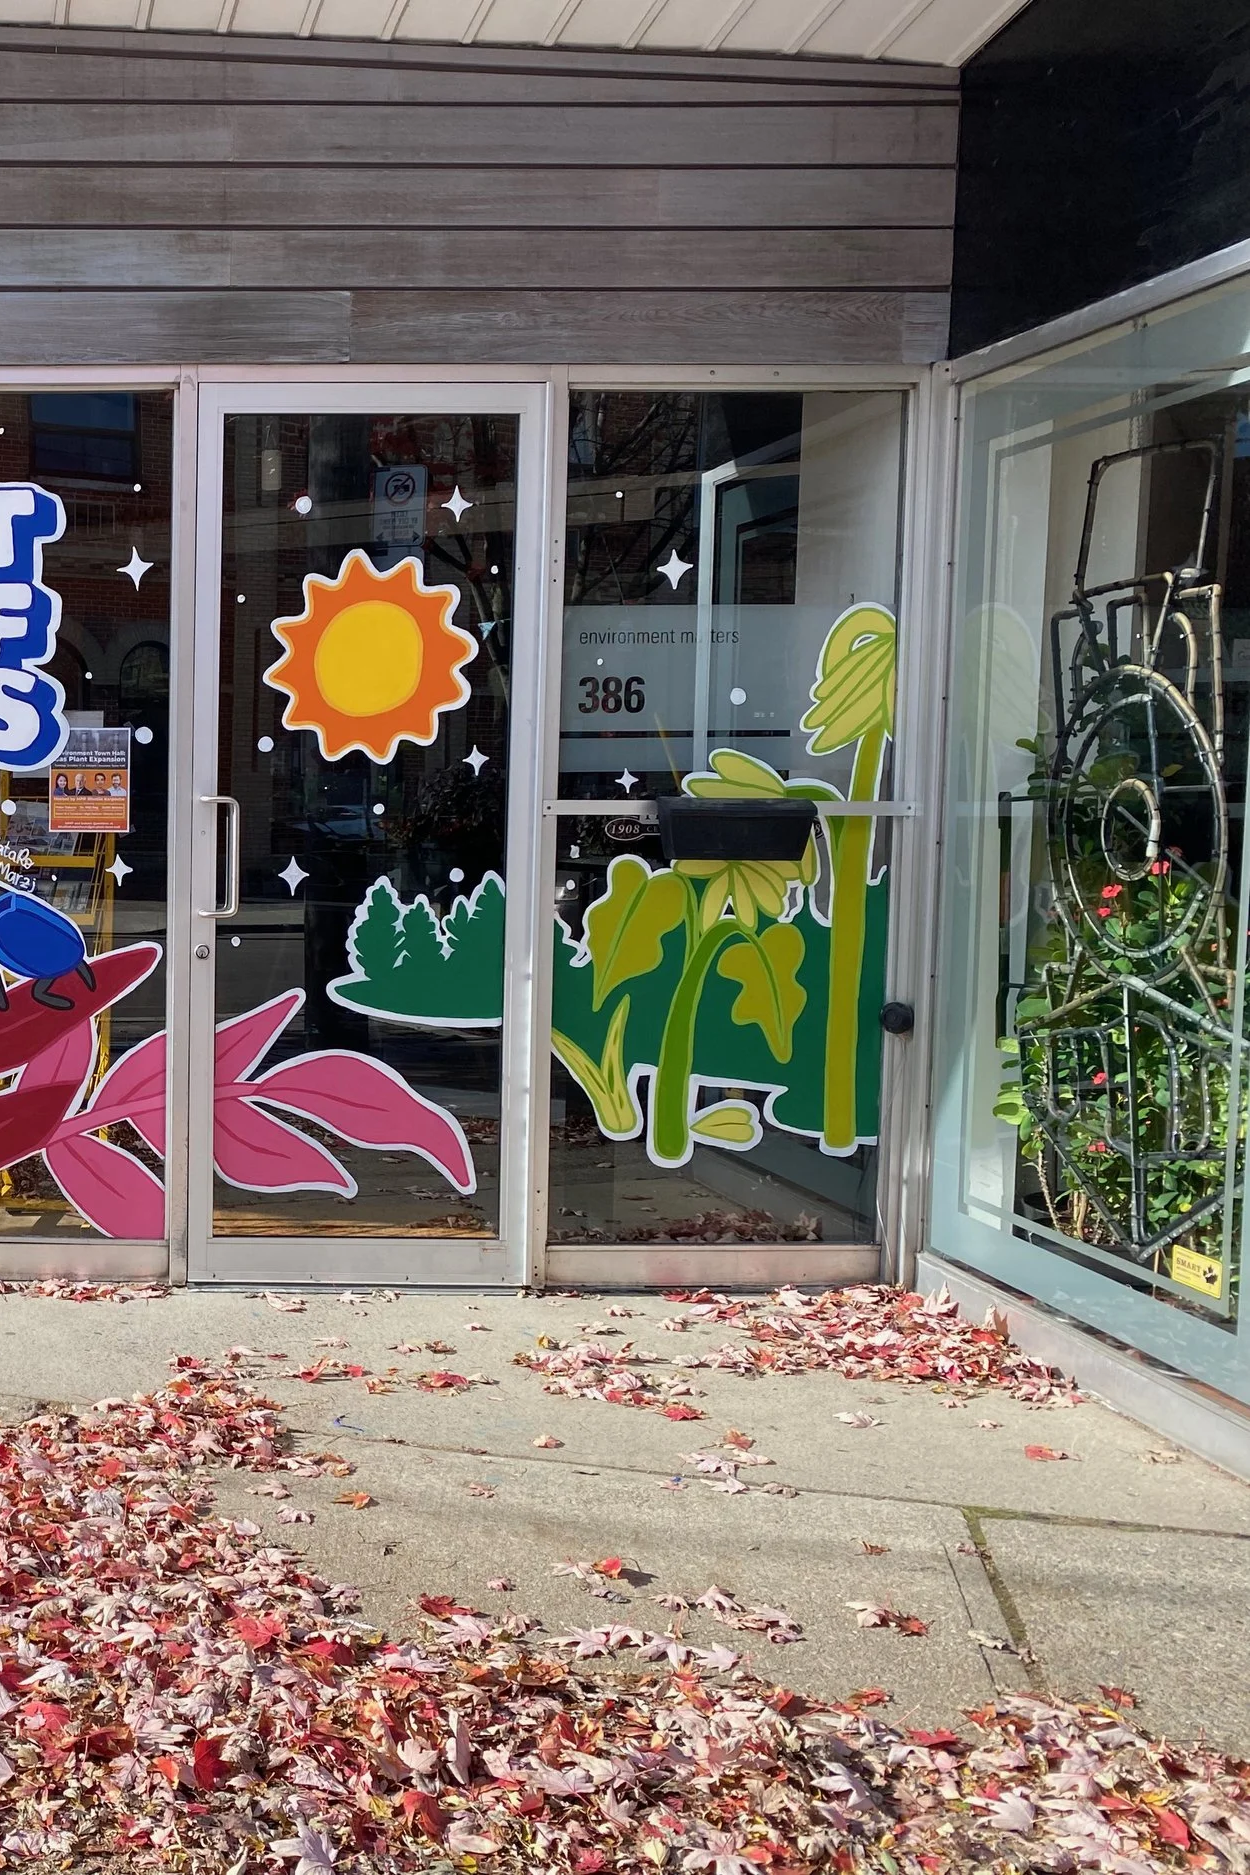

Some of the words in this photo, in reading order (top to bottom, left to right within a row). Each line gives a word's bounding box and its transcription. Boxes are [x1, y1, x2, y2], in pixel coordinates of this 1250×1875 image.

[579, 628, 676, 645] environment
[681, 629, 740, 644] mters
[578, 676, 646, 714] 386
[610, 824, 641, 836] 1908
[1176, 1257, 1202, 1273] SMART
